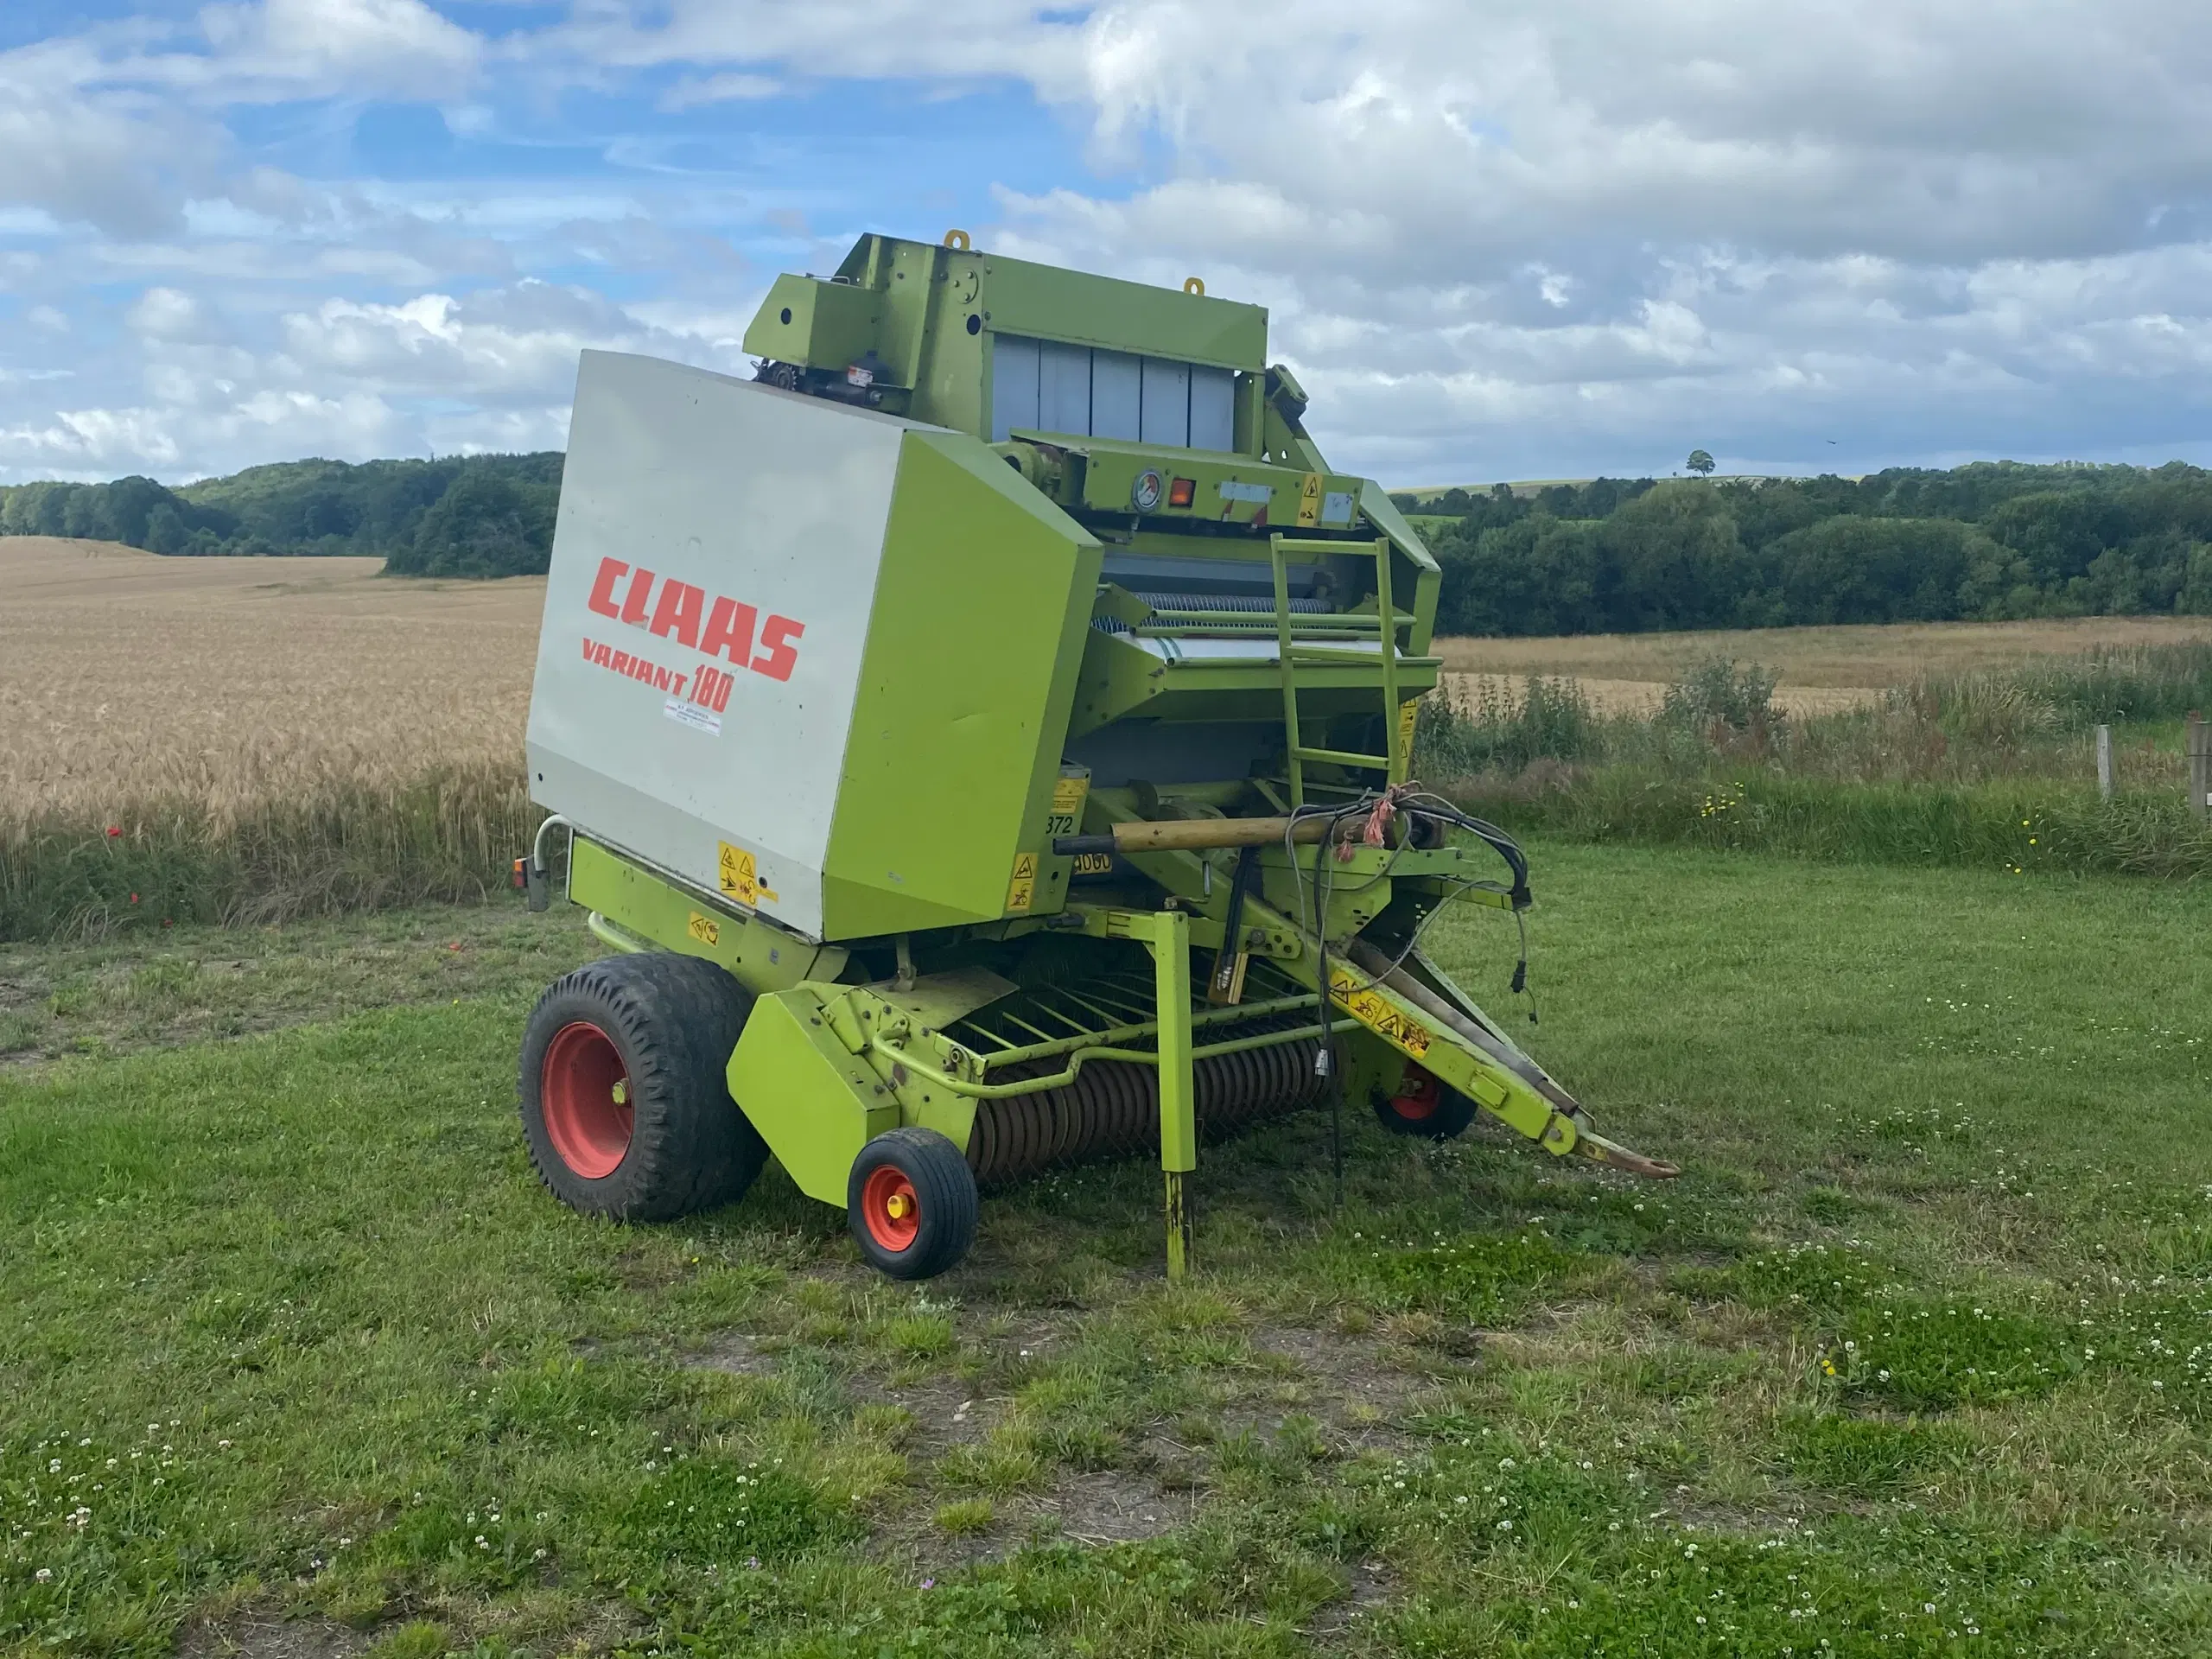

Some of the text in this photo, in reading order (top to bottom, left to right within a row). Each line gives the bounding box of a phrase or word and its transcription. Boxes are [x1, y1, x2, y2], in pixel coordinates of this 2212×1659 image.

[588, 556, 805, 682] CLAAS
[582, 638, 734, 713] VARIANT 180
